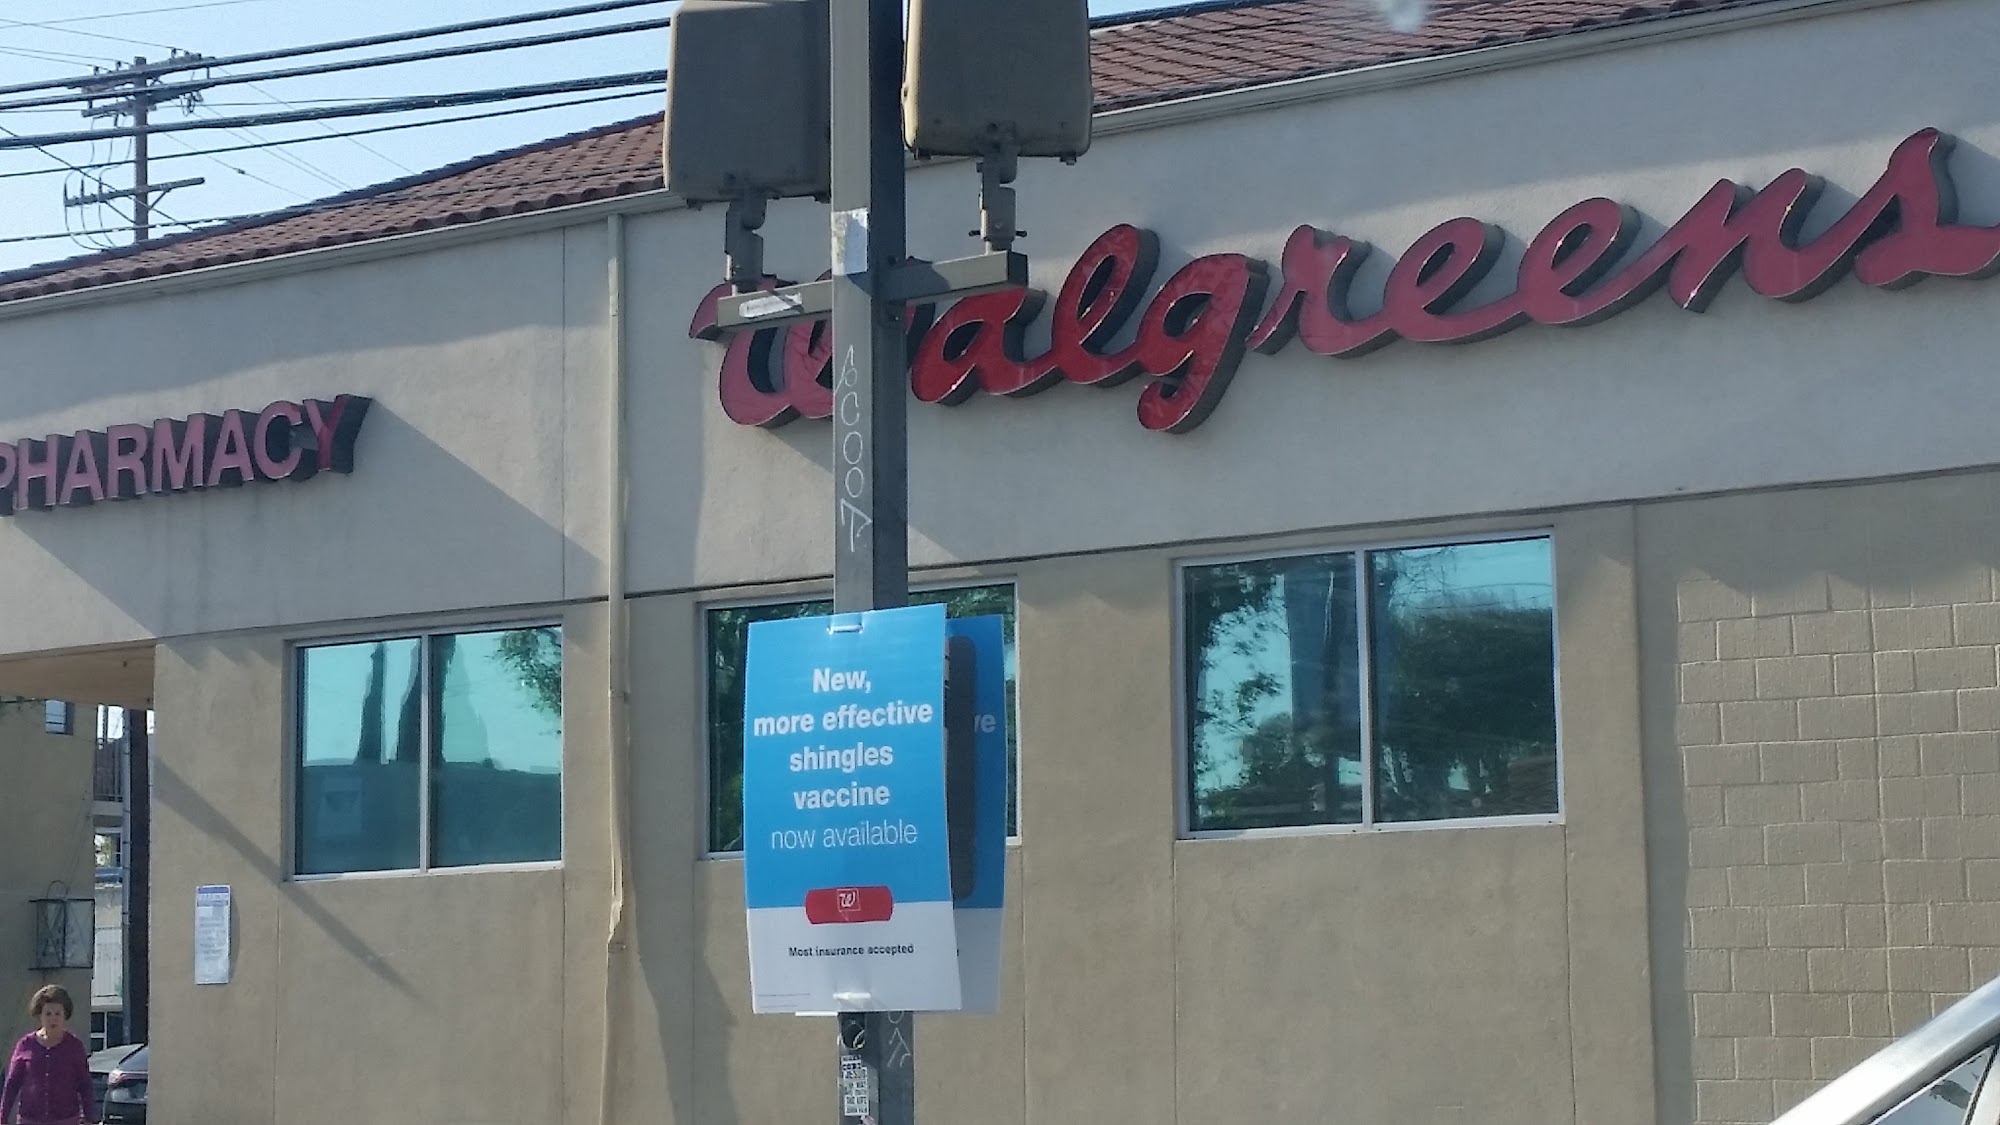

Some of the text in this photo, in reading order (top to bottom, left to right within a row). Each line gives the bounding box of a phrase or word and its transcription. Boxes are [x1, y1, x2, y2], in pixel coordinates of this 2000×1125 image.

[812, 667, 872, 693] New,
[753, 699, 933, 736] more effective
[789, 742, 893, 773] shingles
[793, 780, 890, 809] vaccine
[771, 818, 918, 849] now available
[789, 943, 914, 957] Most insurance accepted
